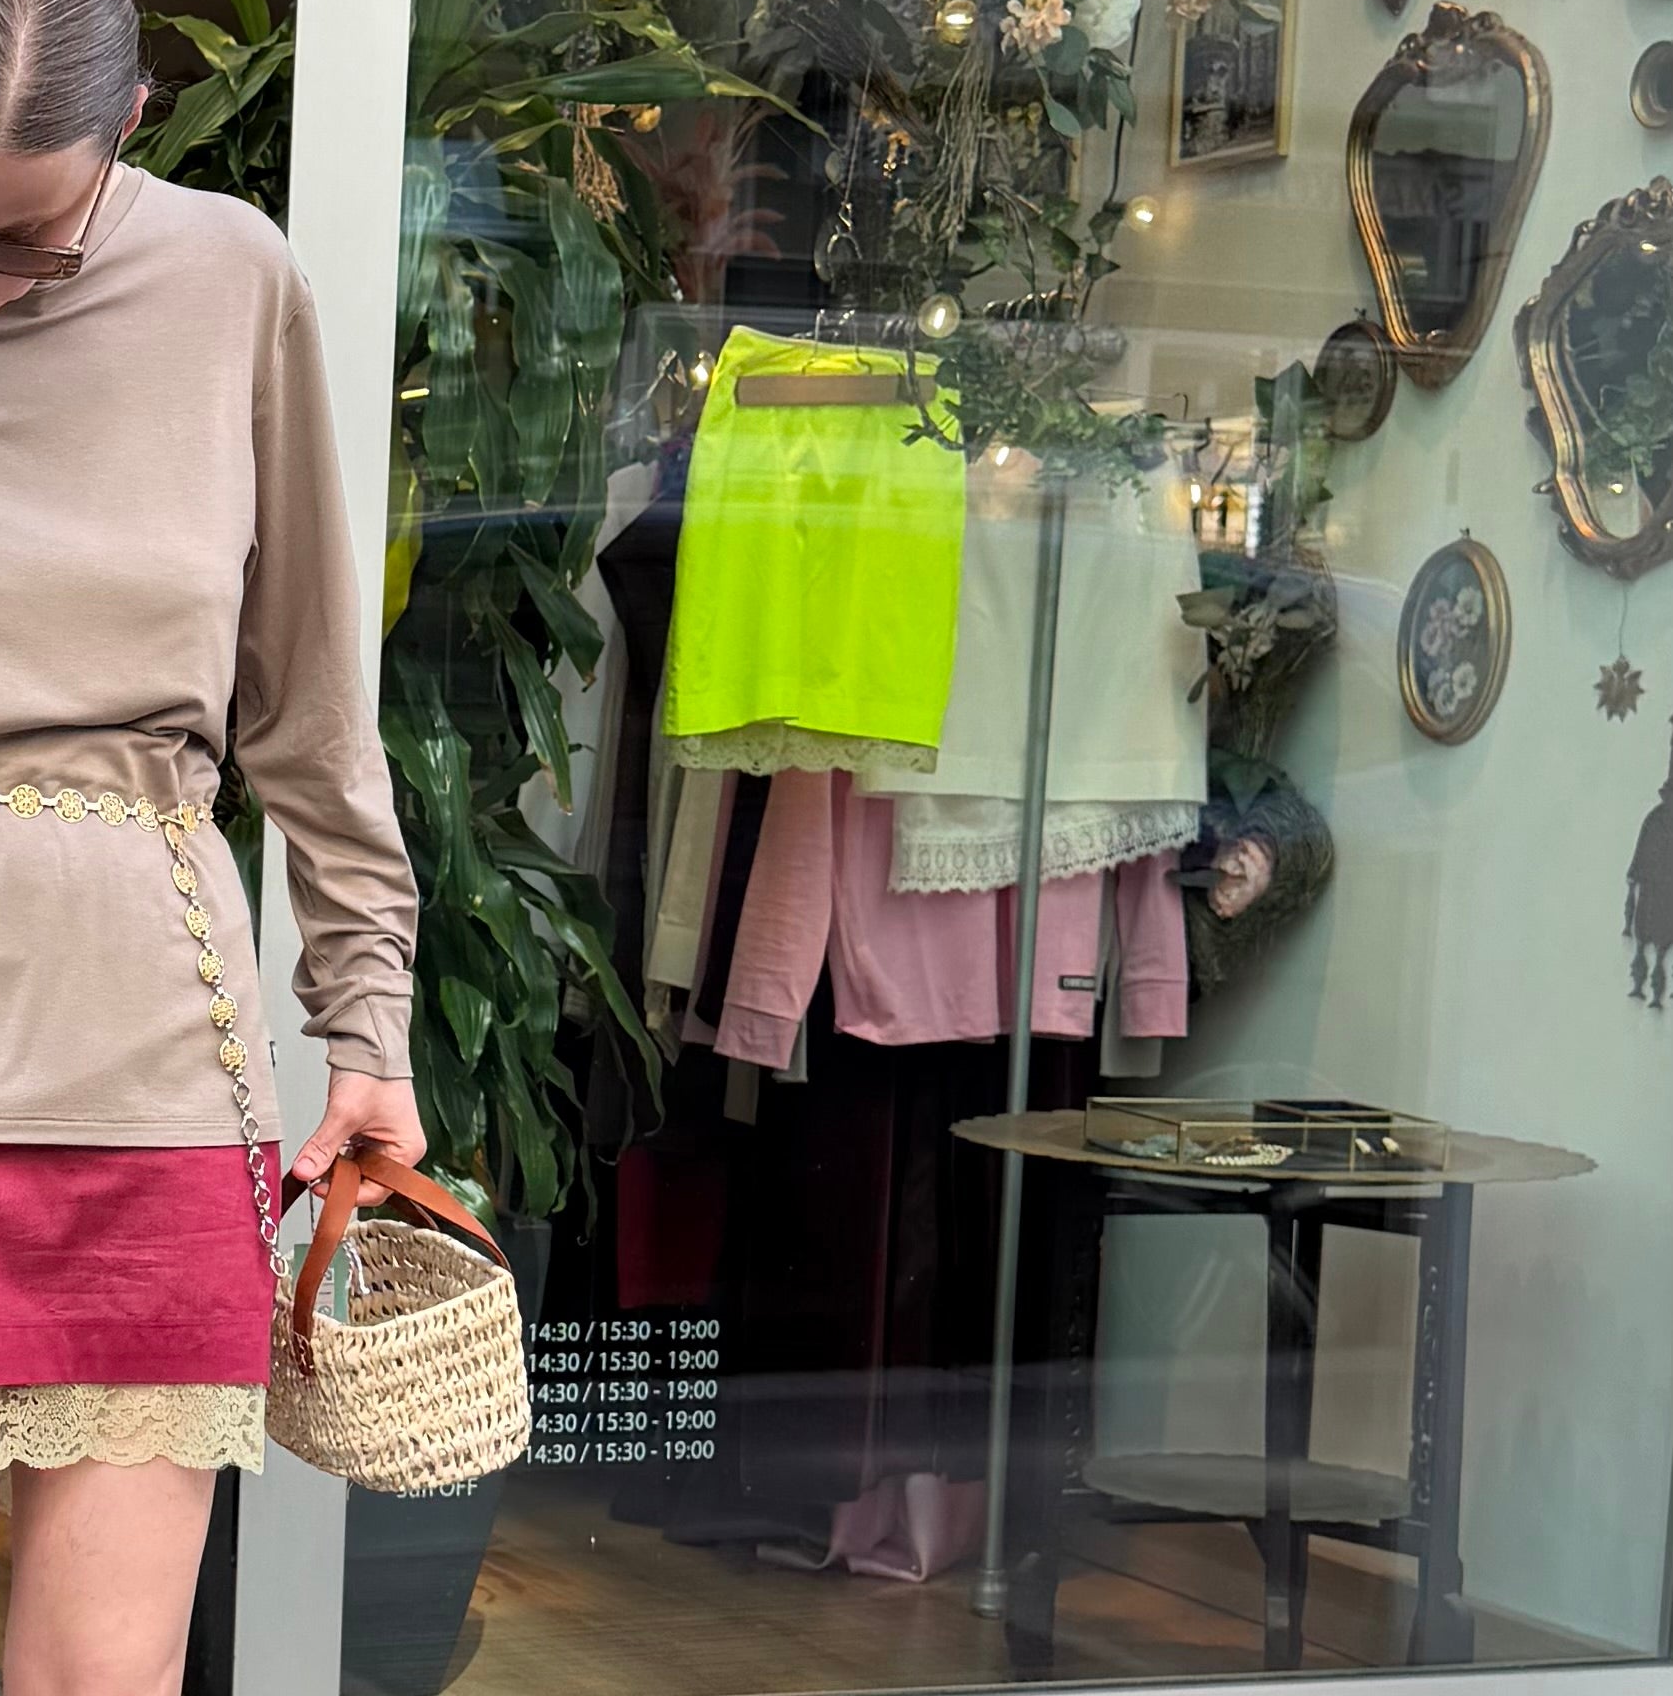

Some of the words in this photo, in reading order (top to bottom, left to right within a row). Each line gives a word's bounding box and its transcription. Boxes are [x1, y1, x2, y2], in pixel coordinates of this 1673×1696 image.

[528, 1322, 580, 1342] 14:30
[584, 1321, 595, 1343] /
[599, 1320, 651, 1341] 15:30
[668, 1319, 720, 1340] 19:00
[528, 1352, 580, 1373] 14:30
[583, 1351, 594, 1373] /
[599, 1351, 651, 1371] 15:30
[668, 1349, 719, 1370] 19:00
[528, 1382, 579, 1404] 14:30
[582, 1381, 593, 1403] /
[598, 1381, 649, 1402] 15:30
[667, 1379, 718, 1400] 19:00
[580, 1412, 592, 1433] /
[596, 1411, 648, 1432] 15:30
[665, 1409, 716, 1430] 19:00
[527, 1443, 577, 1465] 14:30
[579, 1442, 590, 1464] /
[595, 1441, 647, 1463] 15:30
[664, 1439, 715, 1460] 19:00
[439, 1477, 479, 1497] OFF
